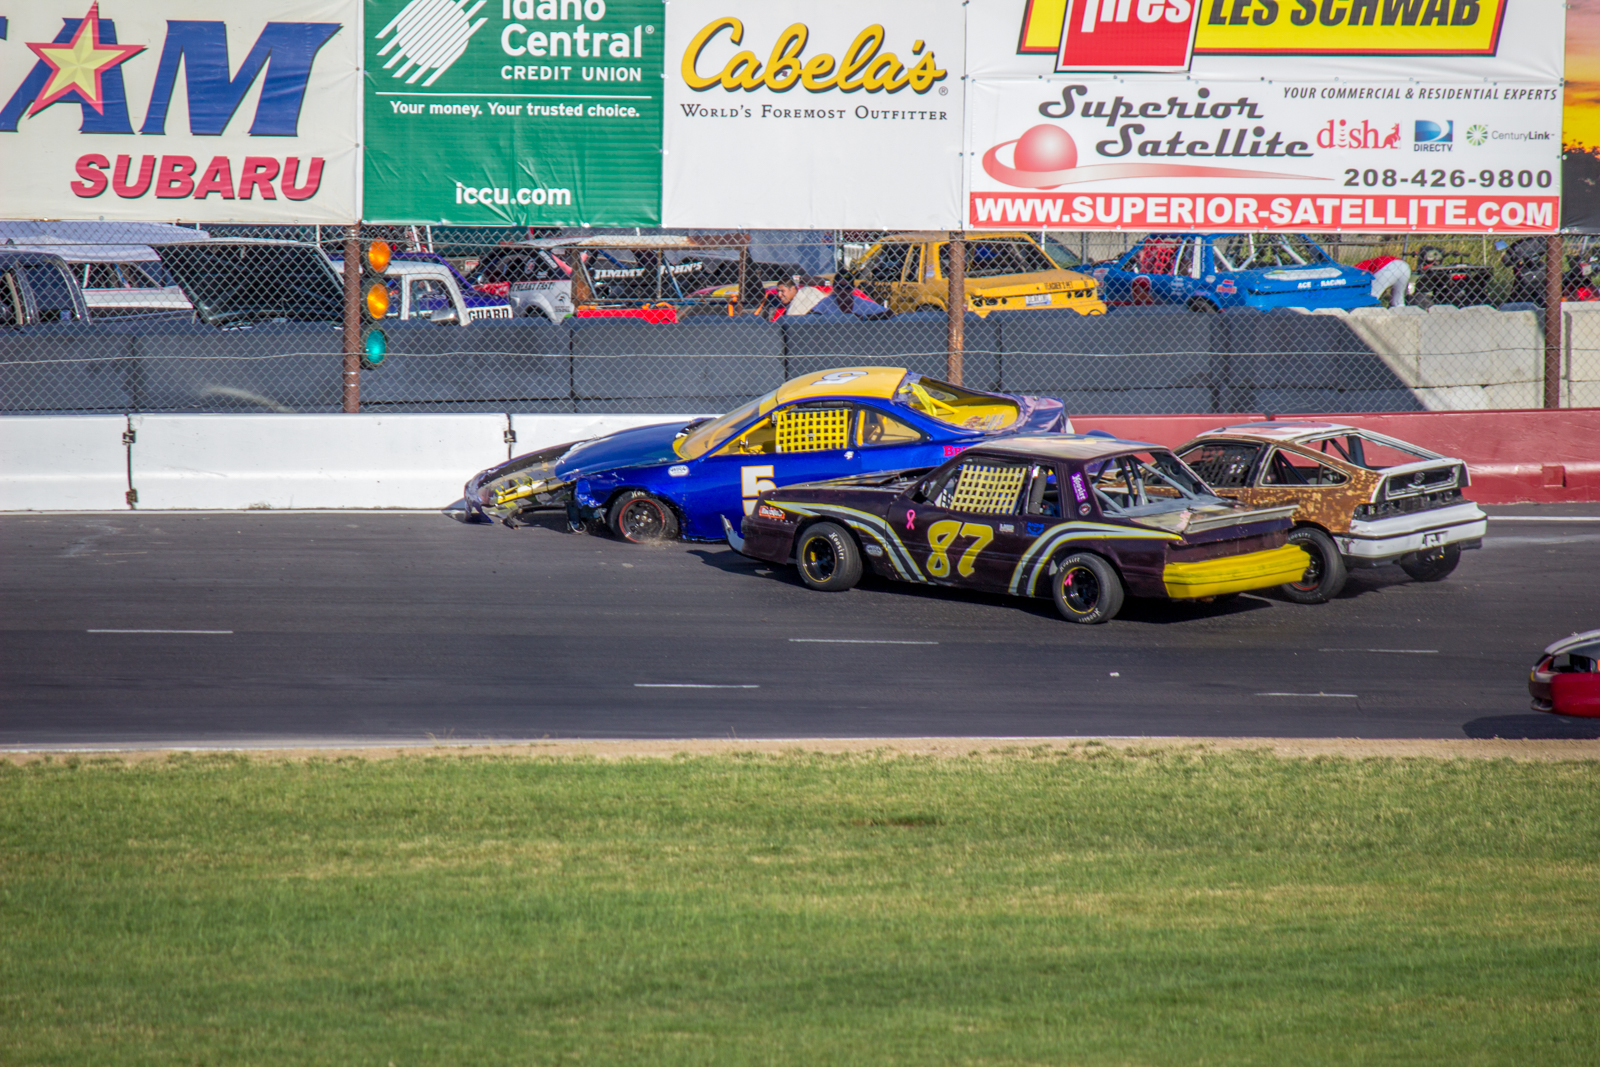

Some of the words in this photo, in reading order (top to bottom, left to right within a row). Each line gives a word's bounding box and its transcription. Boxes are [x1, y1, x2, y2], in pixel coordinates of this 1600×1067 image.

[681, 16, 949, 95] Cabela's
[501, 66, 572, 81] CREDIT
[582, 67, 642, 82] UNION
[1283, 87, 1317, 99] YOUR
[1320, 87, 1401, 99] COMMERCIAL
[1404, 87, 1414, 99] &
[1418, 88, 1499, 100] RESIDENTIAL
[1503, 88, 1557, 100] EXPERTS
[390, 101, 425, 114] Your
[429, 103, 483, 117] money.
[487, 102, 523, 116] Your
[526, 103, 583, 116] trusted
[587, 104, 640, 117] choice.
[1038, 84, 1264, 127] Superior
[1095, 123, 1314, 157] Satellite
[1414, 143, 1453, 152] DIRECTV
[70, 153, 326, 201] SUBARU
[1344, 168, 1552, 188] 208-426-9800
[456, 182, 571, 205] iccu.com
[975, 196, 1552, 226] WWW.SUPERIOR-SATELLITE.COM
[594, 268, 645, 280] JIMMY
[468, 308, 510, 320] GUARD
[926, 519, 994, 578] 87
